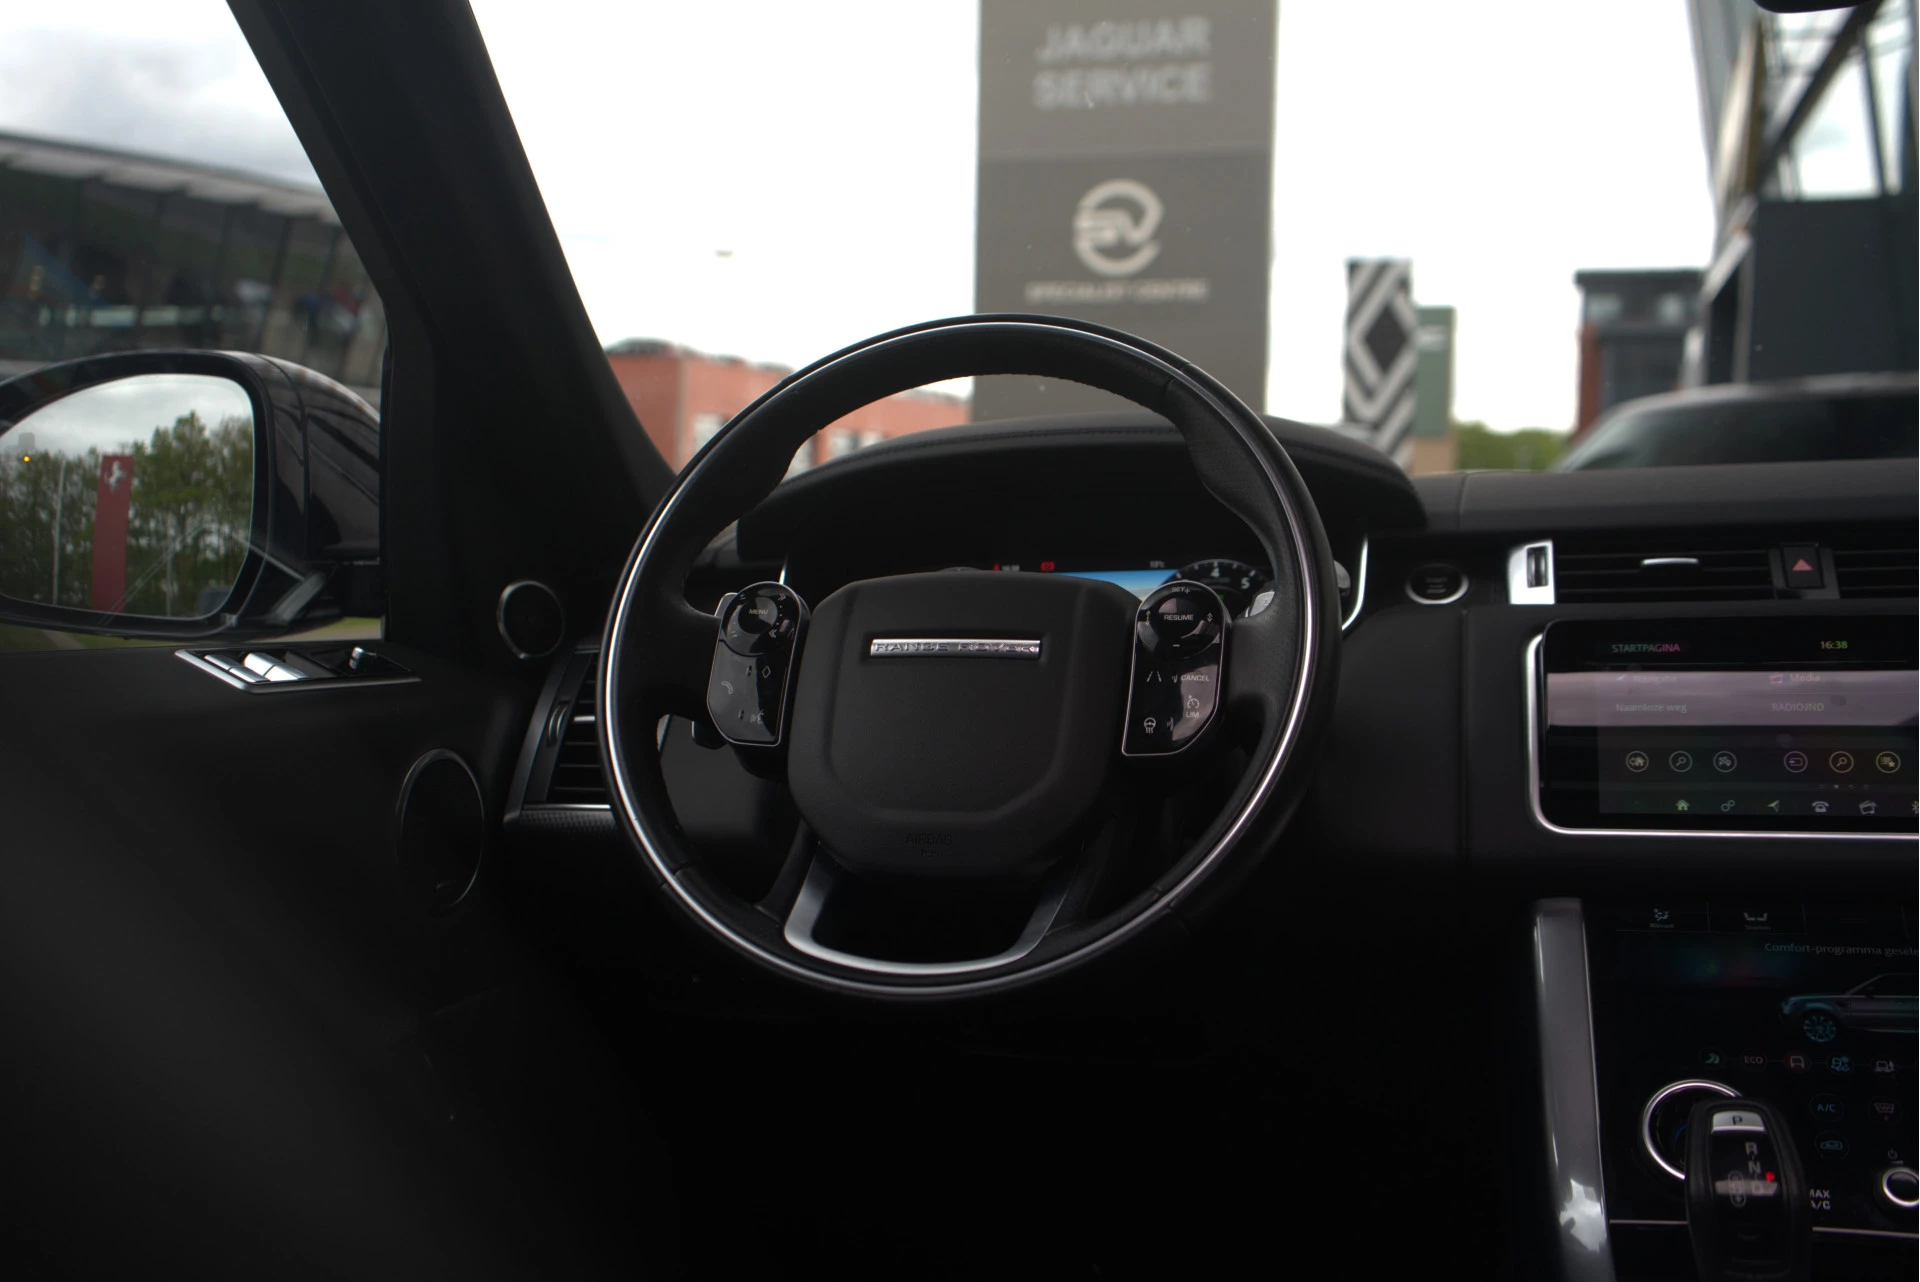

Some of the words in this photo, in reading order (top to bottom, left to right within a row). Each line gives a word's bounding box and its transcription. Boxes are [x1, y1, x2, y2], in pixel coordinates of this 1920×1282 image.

[1036, 16, 1211, 63] JAGUAR
[1033, 63, 1213, 110] SERVICE
[1163, 613, 1194, 622] RESUME
[1611, 642, 1681, 653] STARTPAGINA
[1820, 640, 1848, 650] 16:38
[1180, 673, 1210, 682] CANCEL
[1789, 672, 1820, 682] Media
[1666, 704, 1688, 714] weg
[1764, 943, 1882, 956] Comfort-programma
[1744, 1056, 1763, 1064] ECO
[1817, 1103, 1837, 1113] A/C
[1732, 1115, 1743, 1126] P
[1745, 1141, 1758, 1156] R
[1748, 1160, 1761, 1174] N
